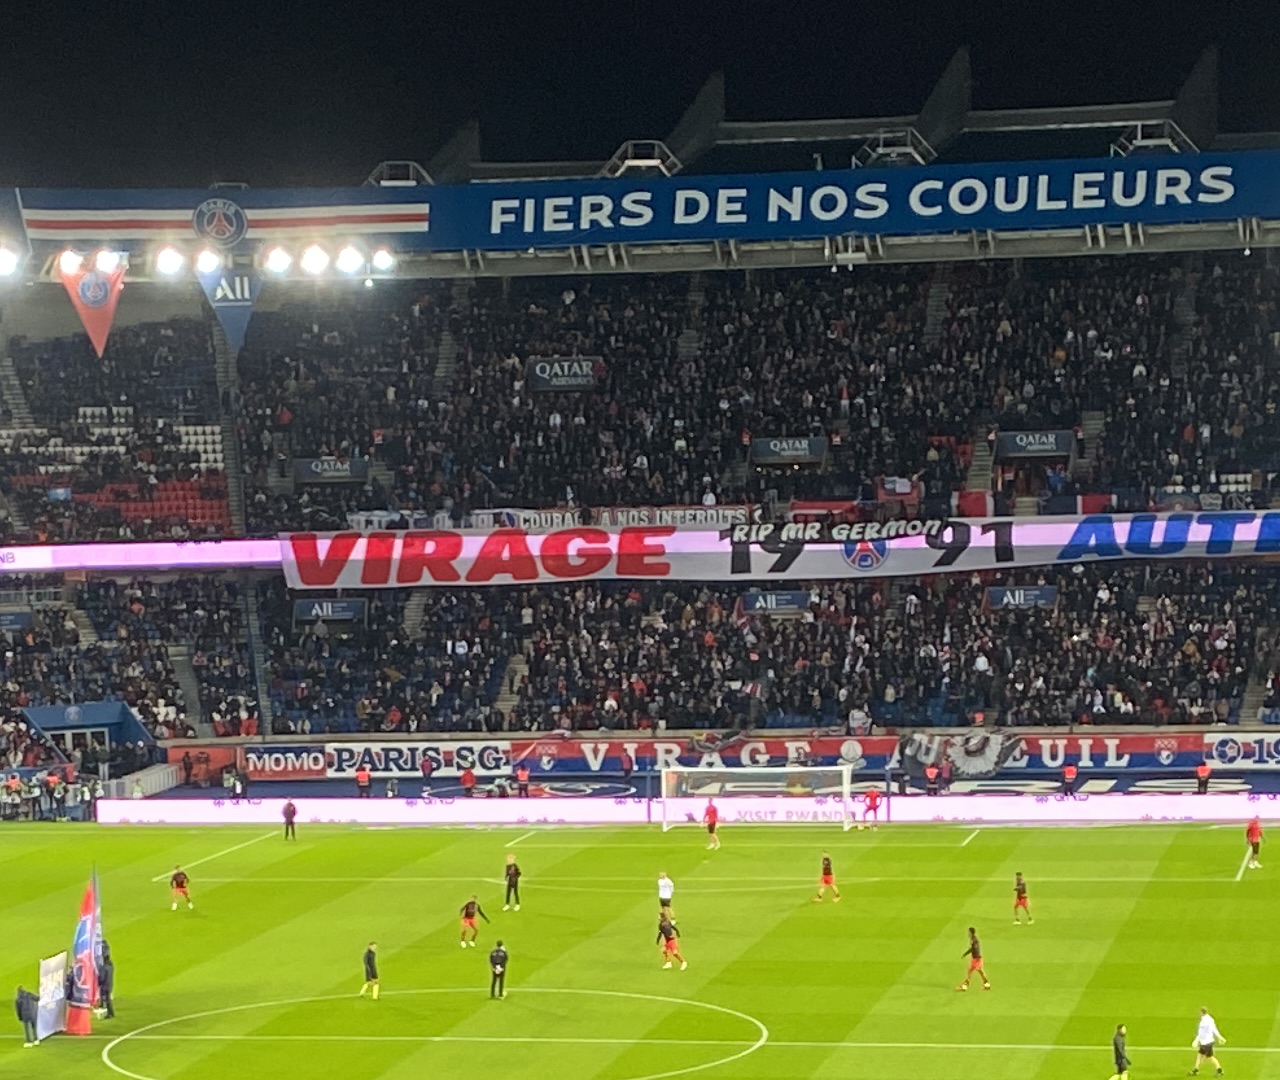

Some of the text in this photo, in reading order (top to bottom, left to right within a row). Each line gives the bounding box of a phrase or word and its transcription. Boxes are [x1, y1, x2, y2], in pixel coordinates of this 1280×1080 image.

[490, 166, 1235, 234] FIERS DE NOS COULEURS
[535, 361, 594, 380] QATAR
[770, 439, 810, 452] QATAR
[1016, 433, 1057, 447] QATAR
[311, 461, 351, 473] QATAR
[617, 510, 650, 527] NOS
[654, 508, 747, 526] INTERDITS
[733, 523, 775, 541] RIP
[781, 522, 821, 541] MR
[290, 525, 677, 586] VIRAGE
[247, 751, 324, 772] MOMO
[333, 747, 443, 772] PARIS
